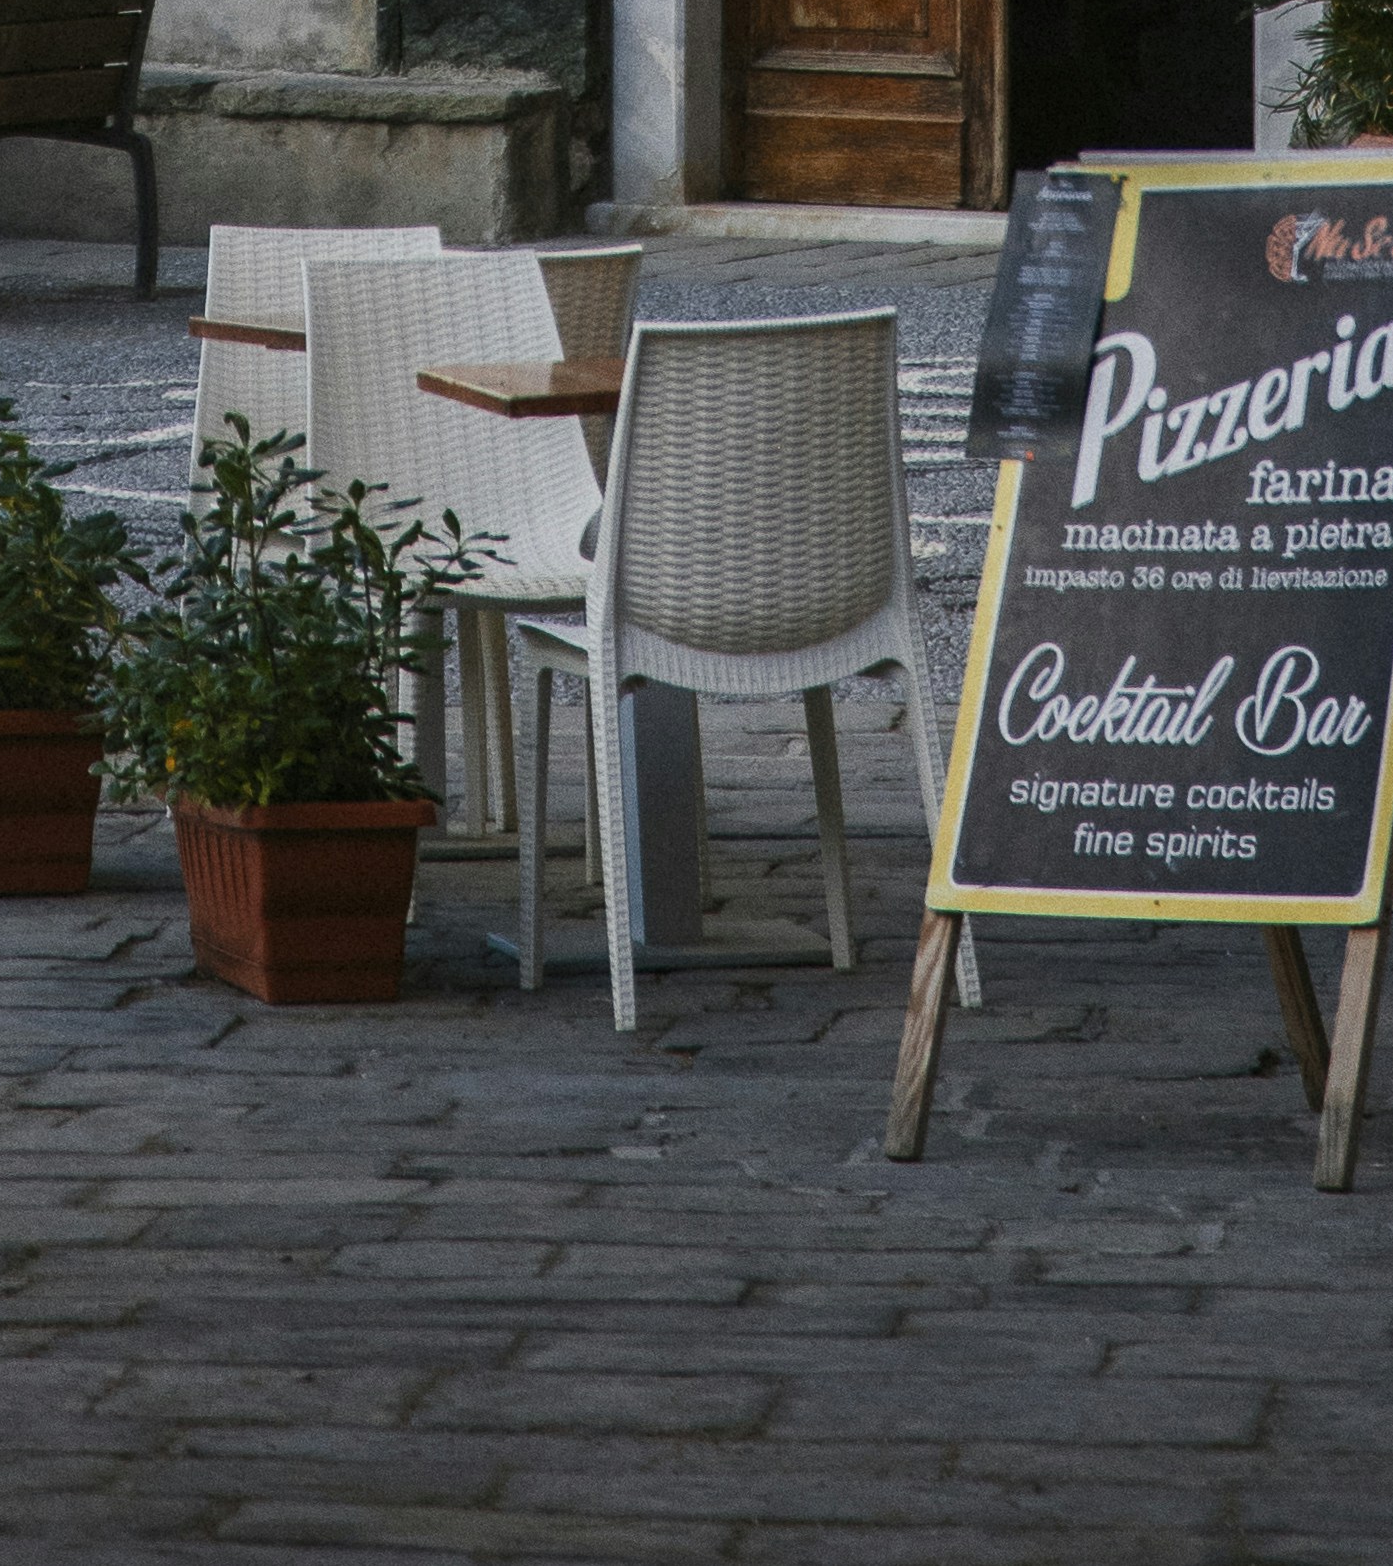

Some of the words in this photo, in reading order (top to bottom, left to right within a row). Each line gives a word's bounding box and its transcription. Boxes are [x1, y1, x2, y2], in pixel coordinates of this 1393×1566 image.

[1061, 519, 1241, 552] macinata
[1250, 524, 1274, 552] a
[1282, 517, 1393, 559] pietra
[1024, 565, 1125, 593] impasto
[1131, 565, 1165, 590] 36
[1170, 569, 1213, 590] ore
[1218, 566, 1243, 590] di
[1250, 566, 1389, 590] lievitazione
[998, 641, 1235, 746] Cocktail
[1235, 645, 1371, 756] Bar
[1010, 772, 1175, 813] signature
[1186, 777, 1336, 811] cocktails
[1073, 822, 1134, 856] fine
[1145, 825, 1258, 866] spirits
